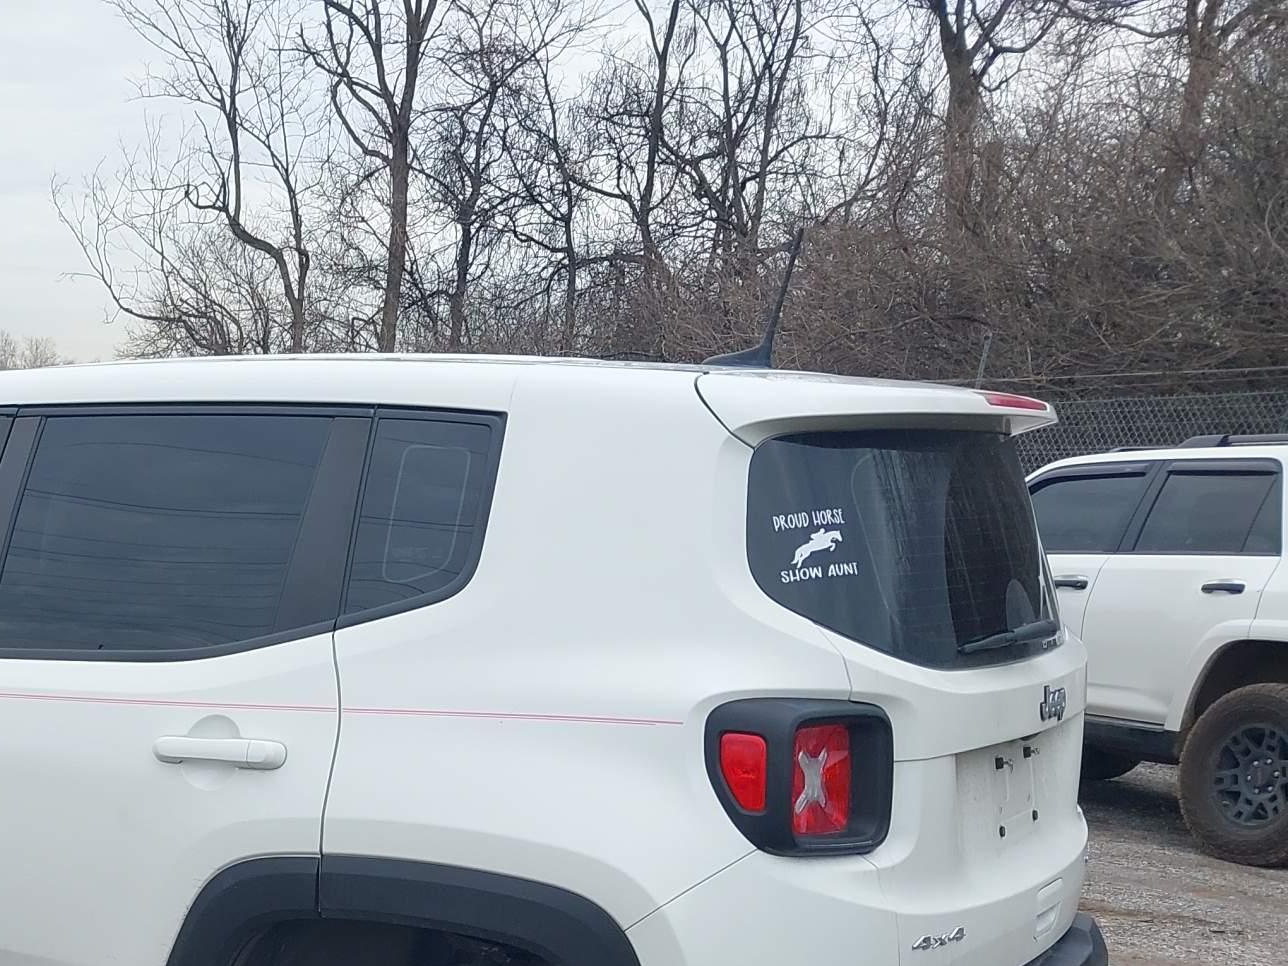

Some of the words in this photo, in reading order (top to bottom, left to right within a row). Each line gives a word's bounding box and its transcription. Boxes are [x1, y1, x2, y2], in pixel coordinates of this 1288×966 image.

[772, 511, 810, 532] PROUD
[811, 508, 845, 526] HORSE
[780, 566, 823, 584] SHOW
[828, 562, 858, 577] AUNT
